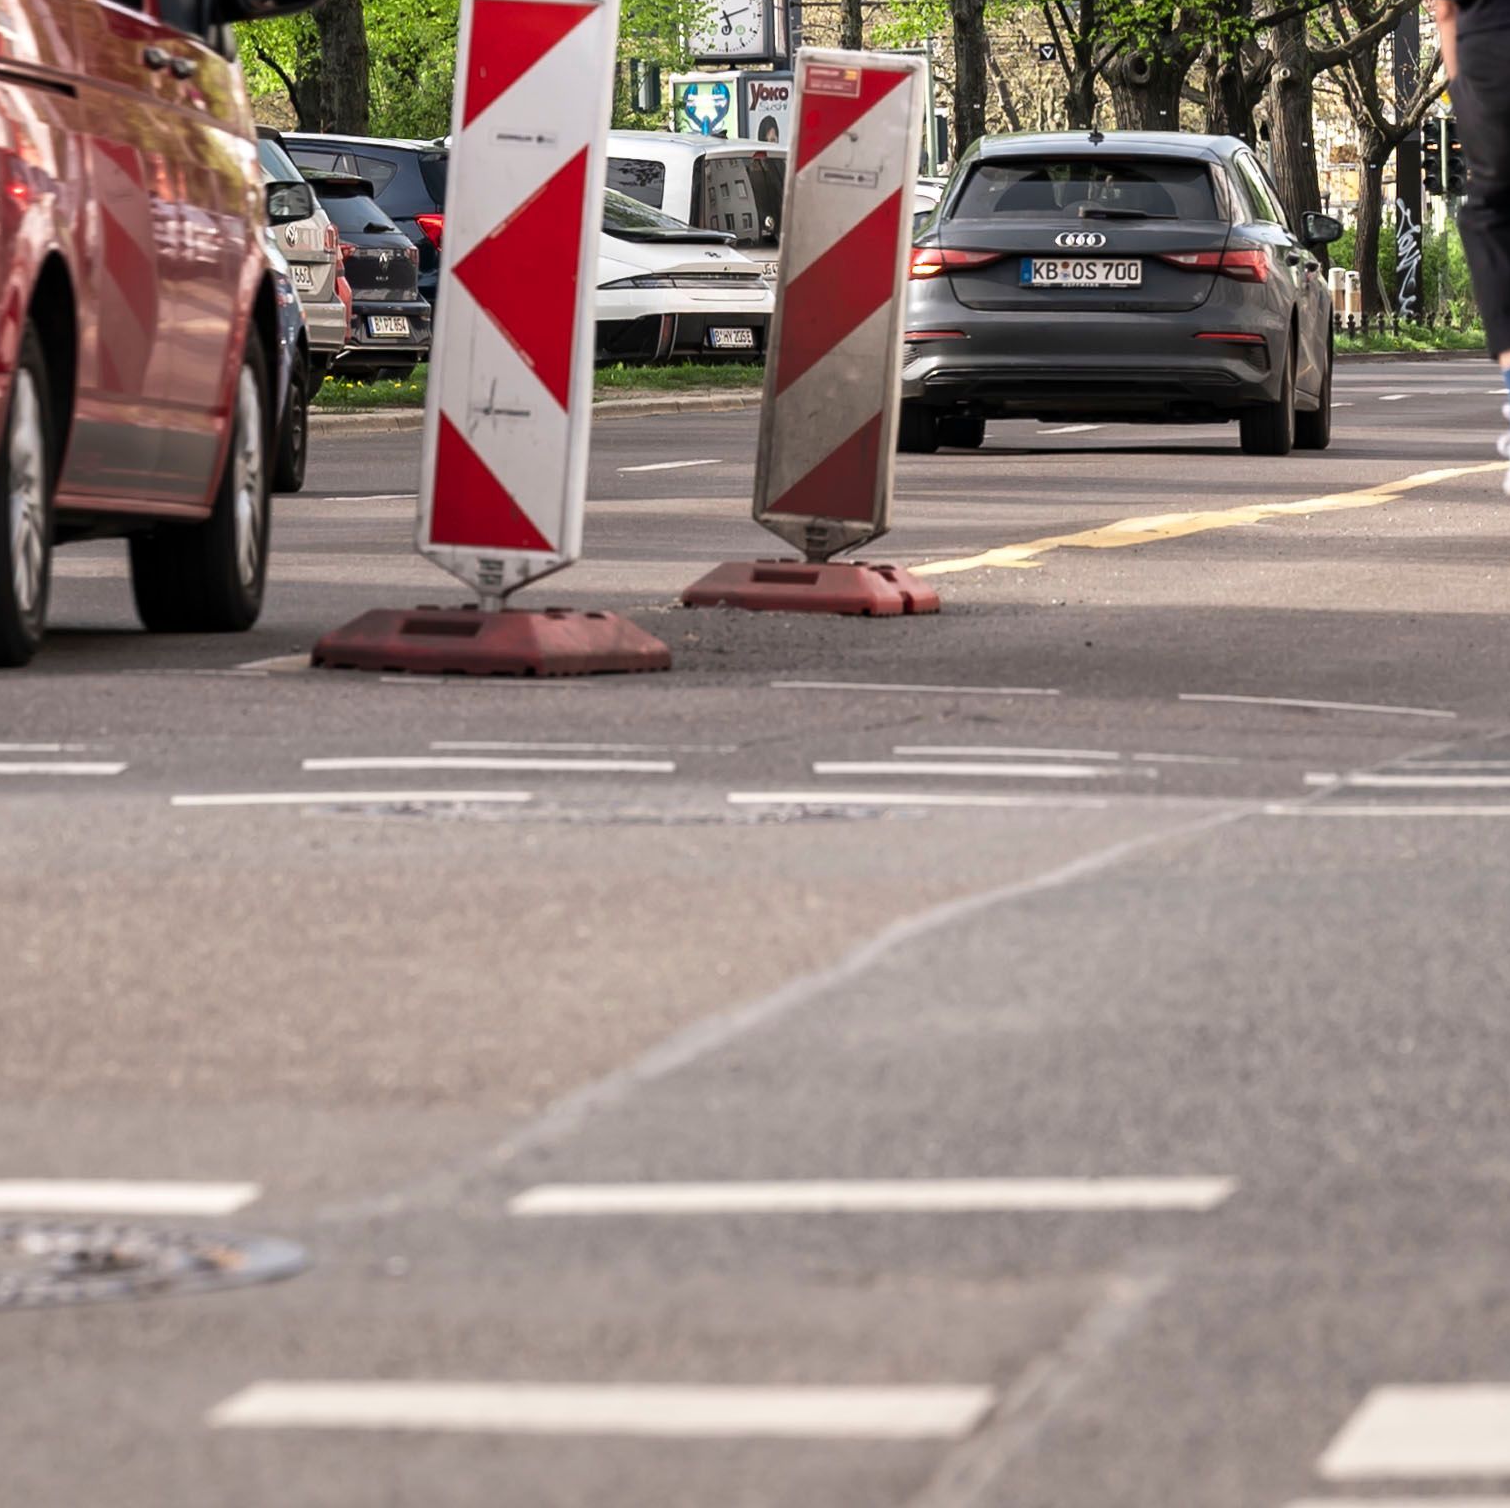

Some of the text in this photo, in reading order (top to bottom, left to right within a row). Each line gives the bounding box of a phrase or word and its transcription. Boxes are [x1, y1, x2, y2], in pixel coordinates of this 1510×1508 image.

[1033, 262, 1139, 280] KB OS 700
[375, 316, 381, 332] B
